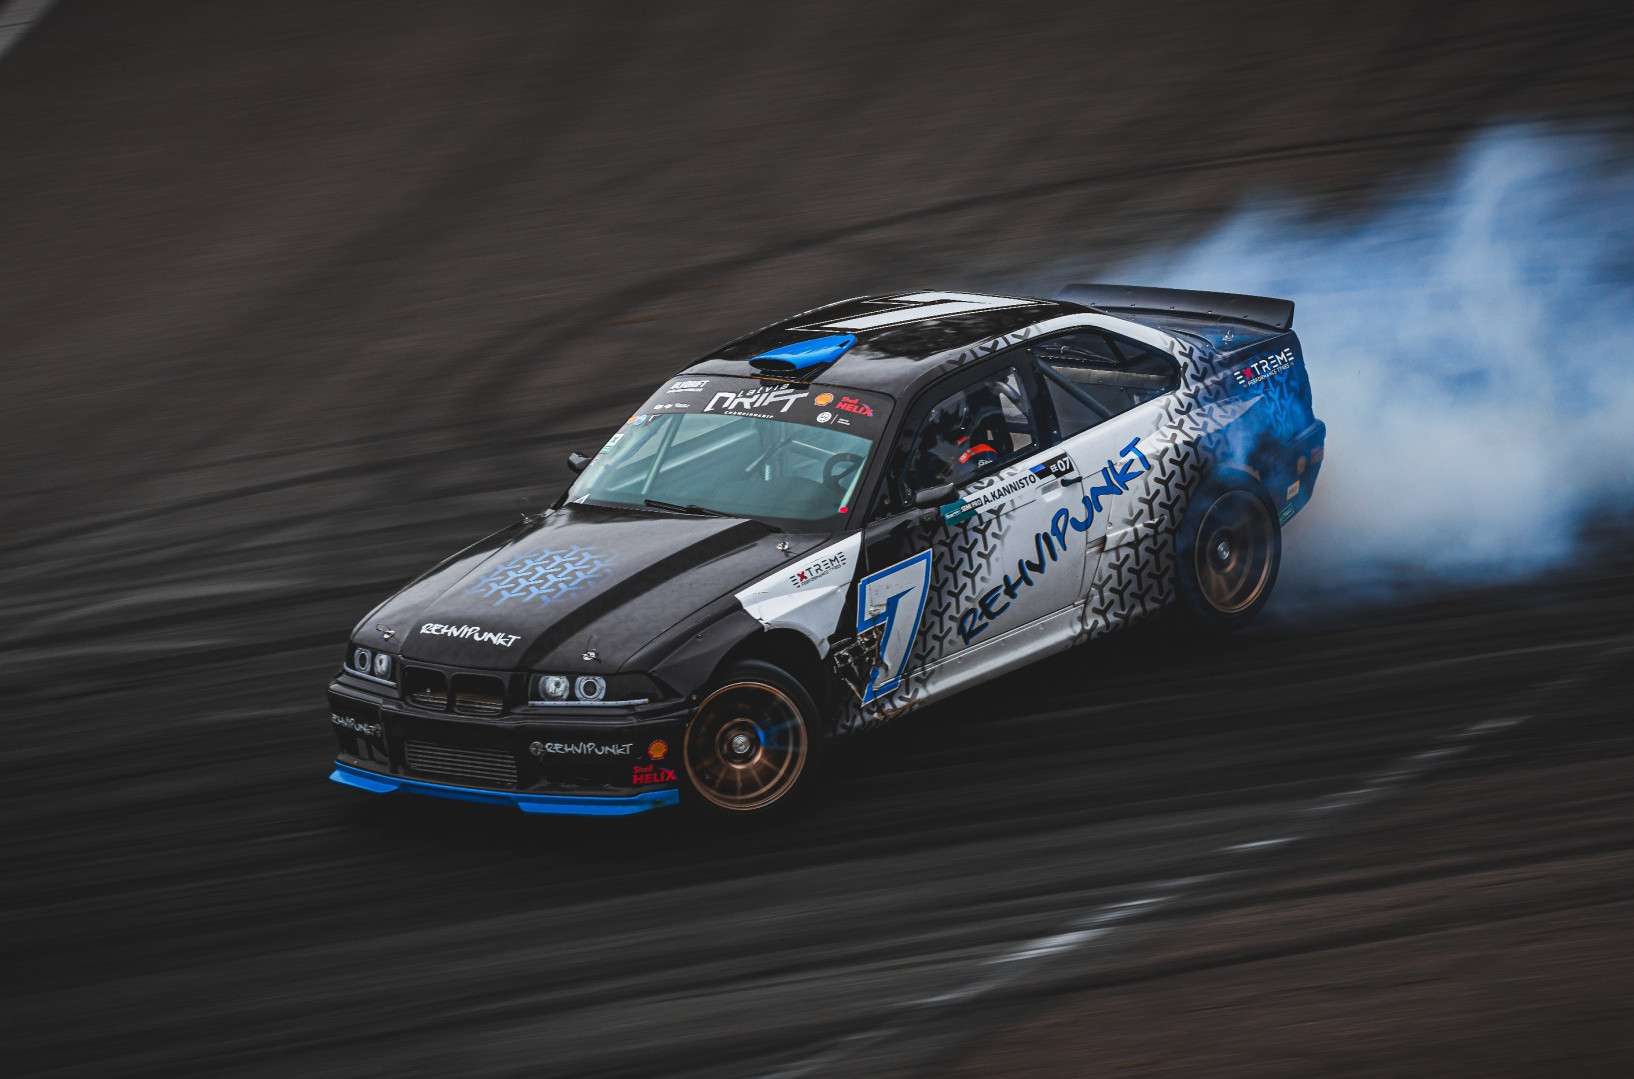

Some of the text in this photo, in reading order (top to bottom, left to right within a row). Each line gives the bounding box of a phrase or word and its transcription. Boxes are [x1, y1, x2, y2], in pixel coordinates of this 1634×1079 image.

[1233, 347, 1295, 385] EXTREME
[703, 388, 810, 413] DRIFT
[835, 401, 874, 417] HELIX
[1056, 457, 1071, 472] 07
[983, 474, 1037, 505] A.KANNISTO
[957, 436, 1151, 645] REHVIPUNKT
[789, 551, 847, 586] EXTREME
[420, 623, 521, 648] REHVIPUNKT
[856, 548, 933, 707] 7
[544, 741, 634, 756] REHVIPUNKT
[632, 767, 678, 785] HELIX
[633, 764, 654, 774] Shell
